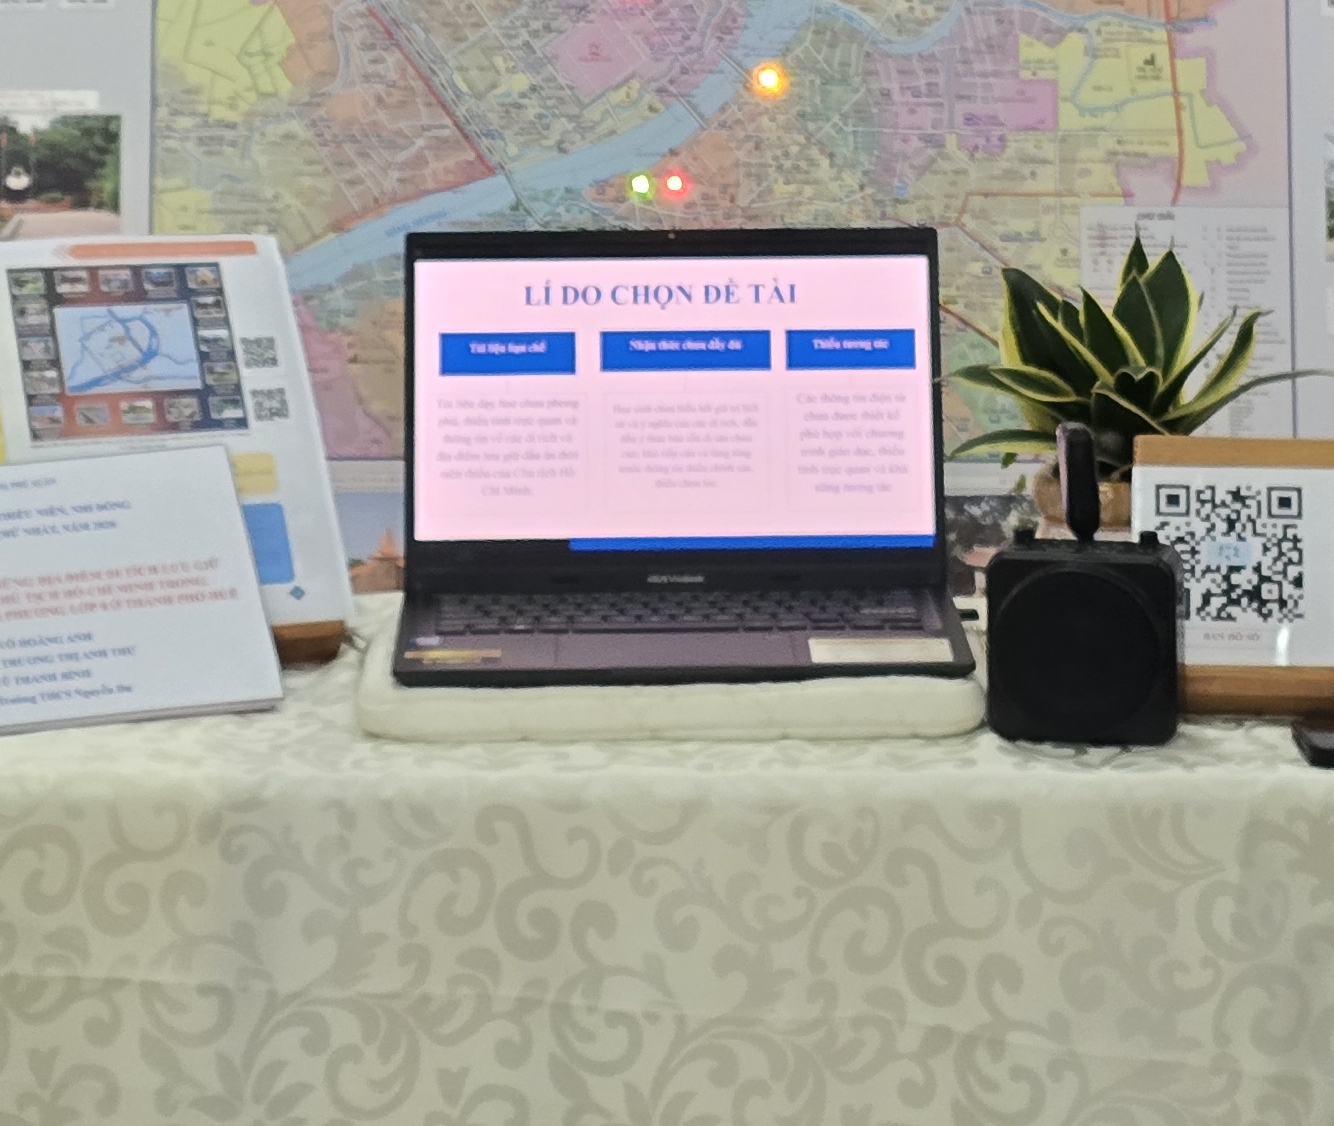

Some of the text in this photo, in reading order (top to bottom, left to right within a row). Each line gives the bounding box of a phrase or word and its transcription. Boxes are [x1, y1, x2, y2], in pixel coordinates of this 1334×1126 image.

[525, 278, 796, 309] LÍ DO CHỌN ĐỀ TÀI
